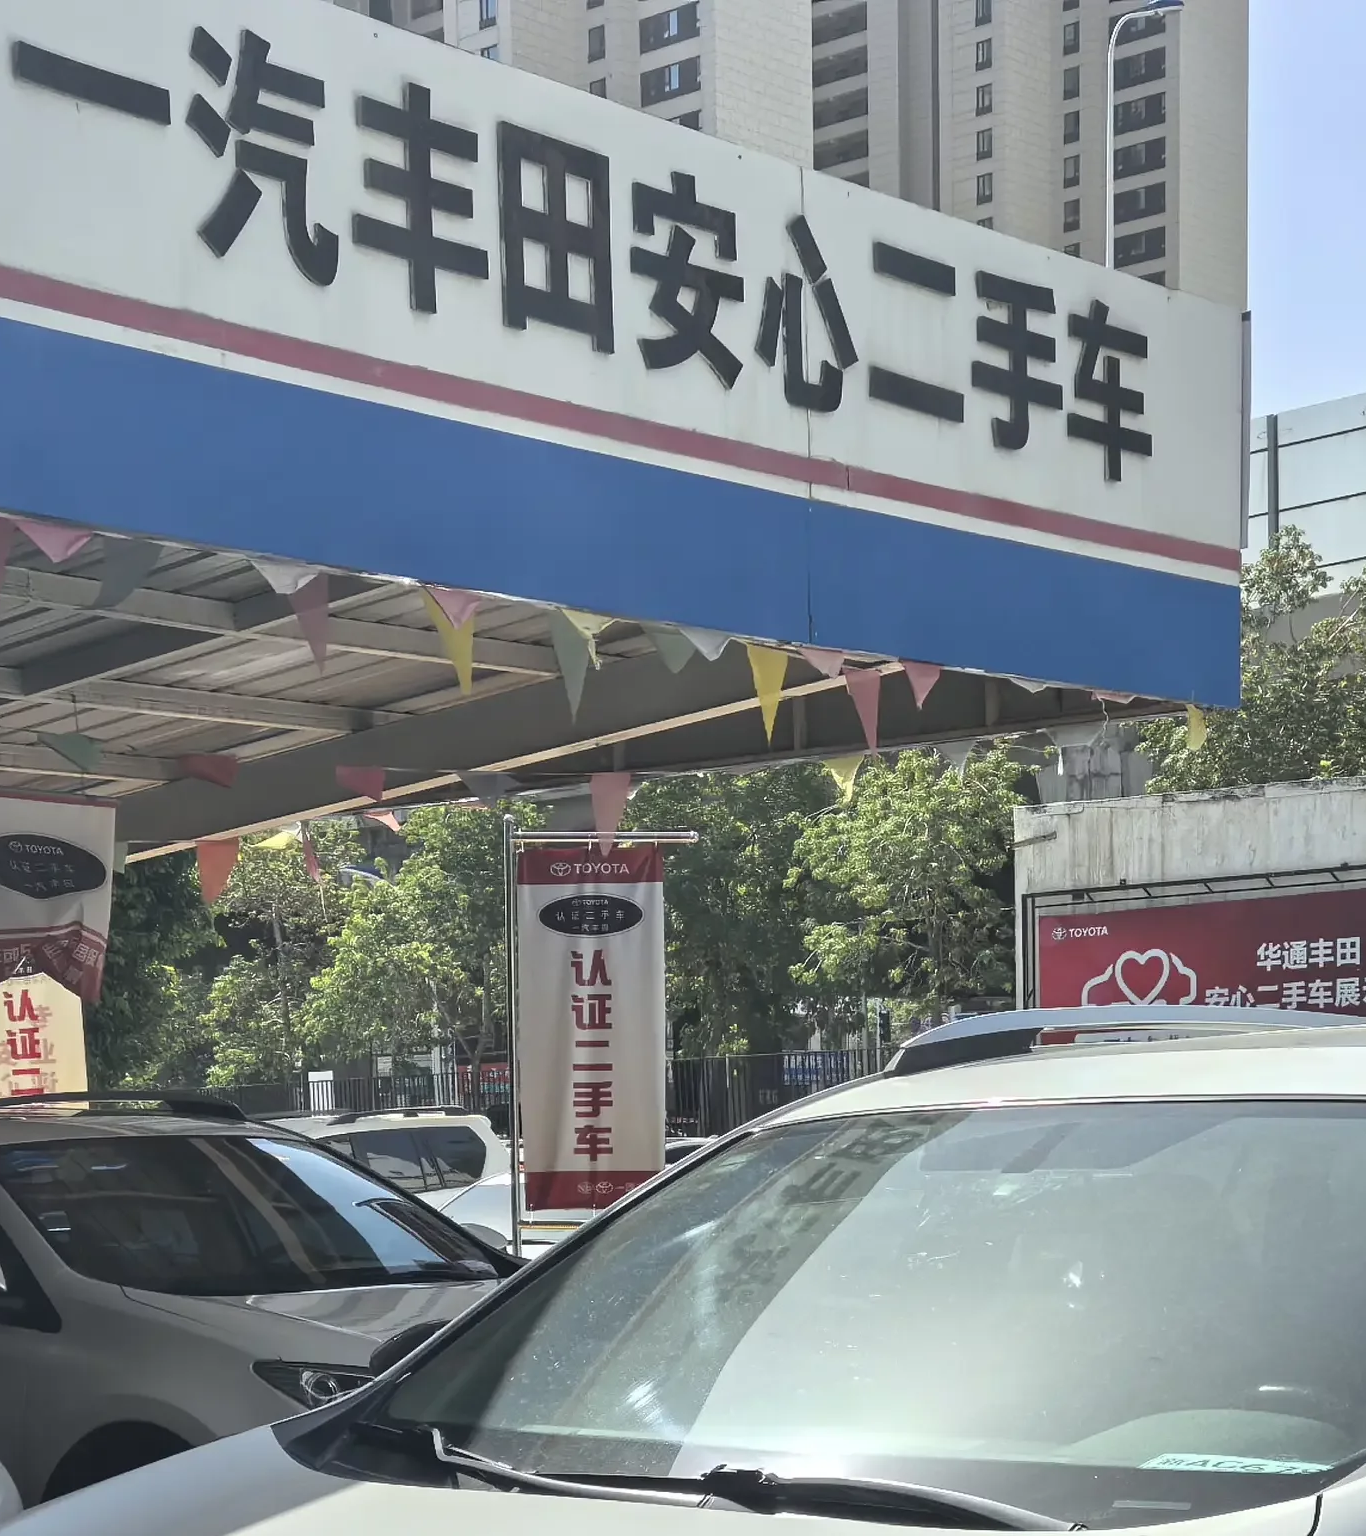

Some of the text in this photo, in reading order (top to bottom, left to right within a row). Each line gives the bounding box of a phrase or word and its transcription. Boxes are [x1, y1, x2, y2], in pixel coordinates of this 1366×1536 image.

[11, 26, 1154, 482] 一汽丰田安心二手车
[25, 844, 64, 856] TOYOTA
[574, 863, 630, 875] TOYOTA
[583, 899, 609, 907] TOYOTA
[1069, 926, 1109, 938] TOYOTA
[1256, 936, 1361, 972] 华通丰田
[571, 950, 614, 1163] 认证二手车
